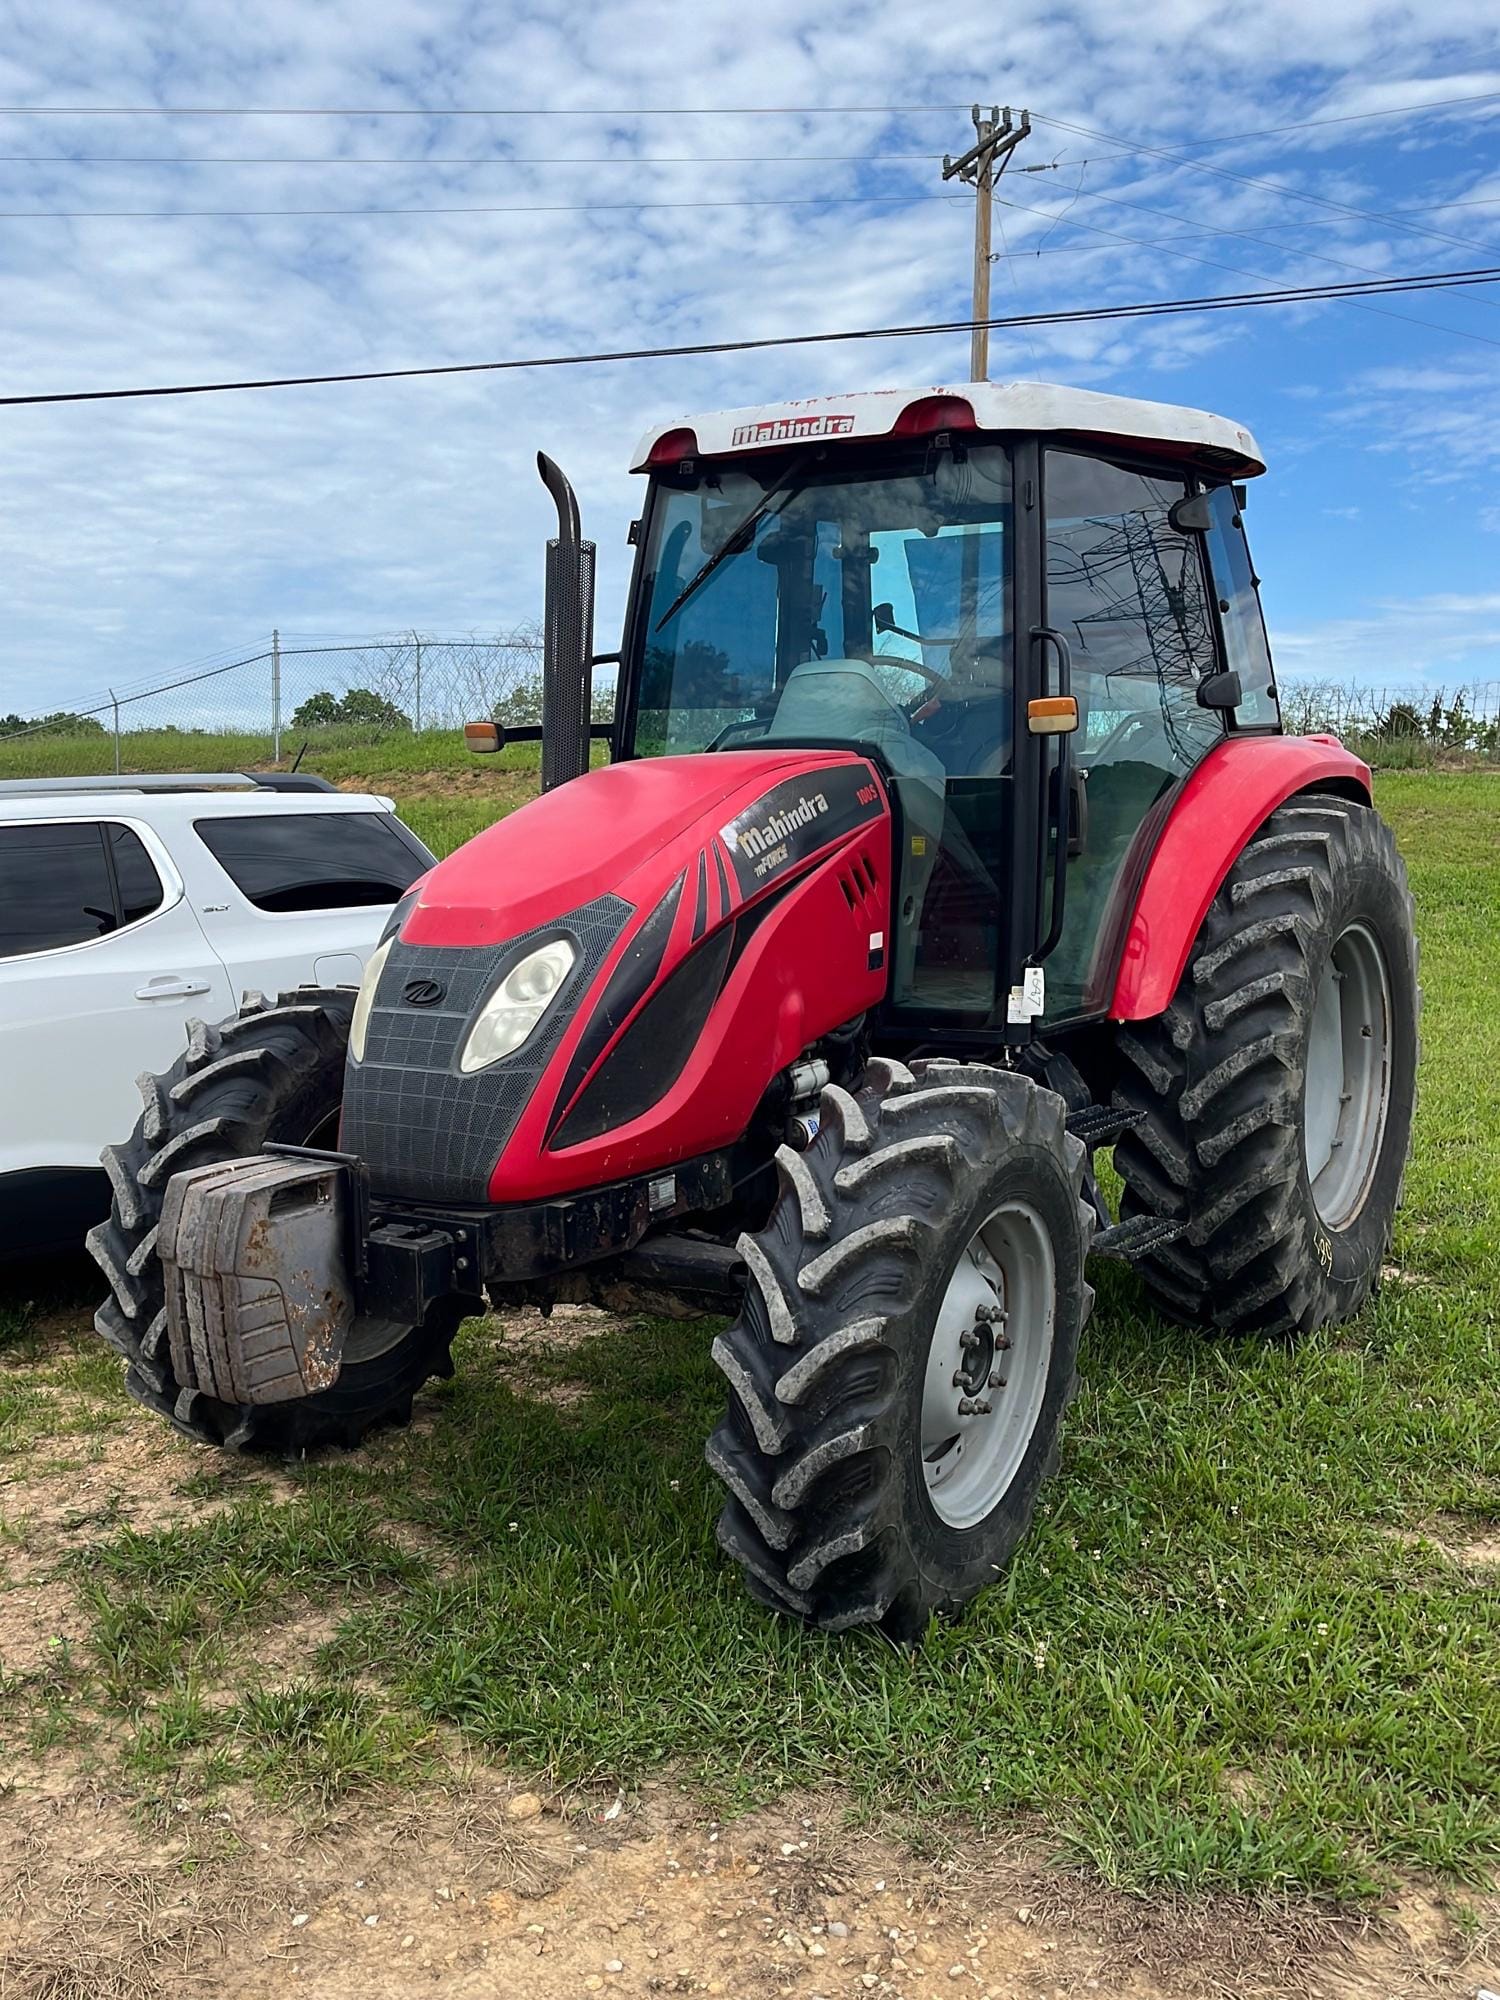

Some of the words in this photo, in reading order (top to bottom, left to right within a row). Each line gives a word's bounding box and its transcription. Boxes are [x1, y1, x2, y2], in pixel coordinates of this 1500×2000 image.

[733, 416, 854, 445] Mahindra
[856, 784, 878, 805] 100S
[737, 793, 829, 859] Mahindra
